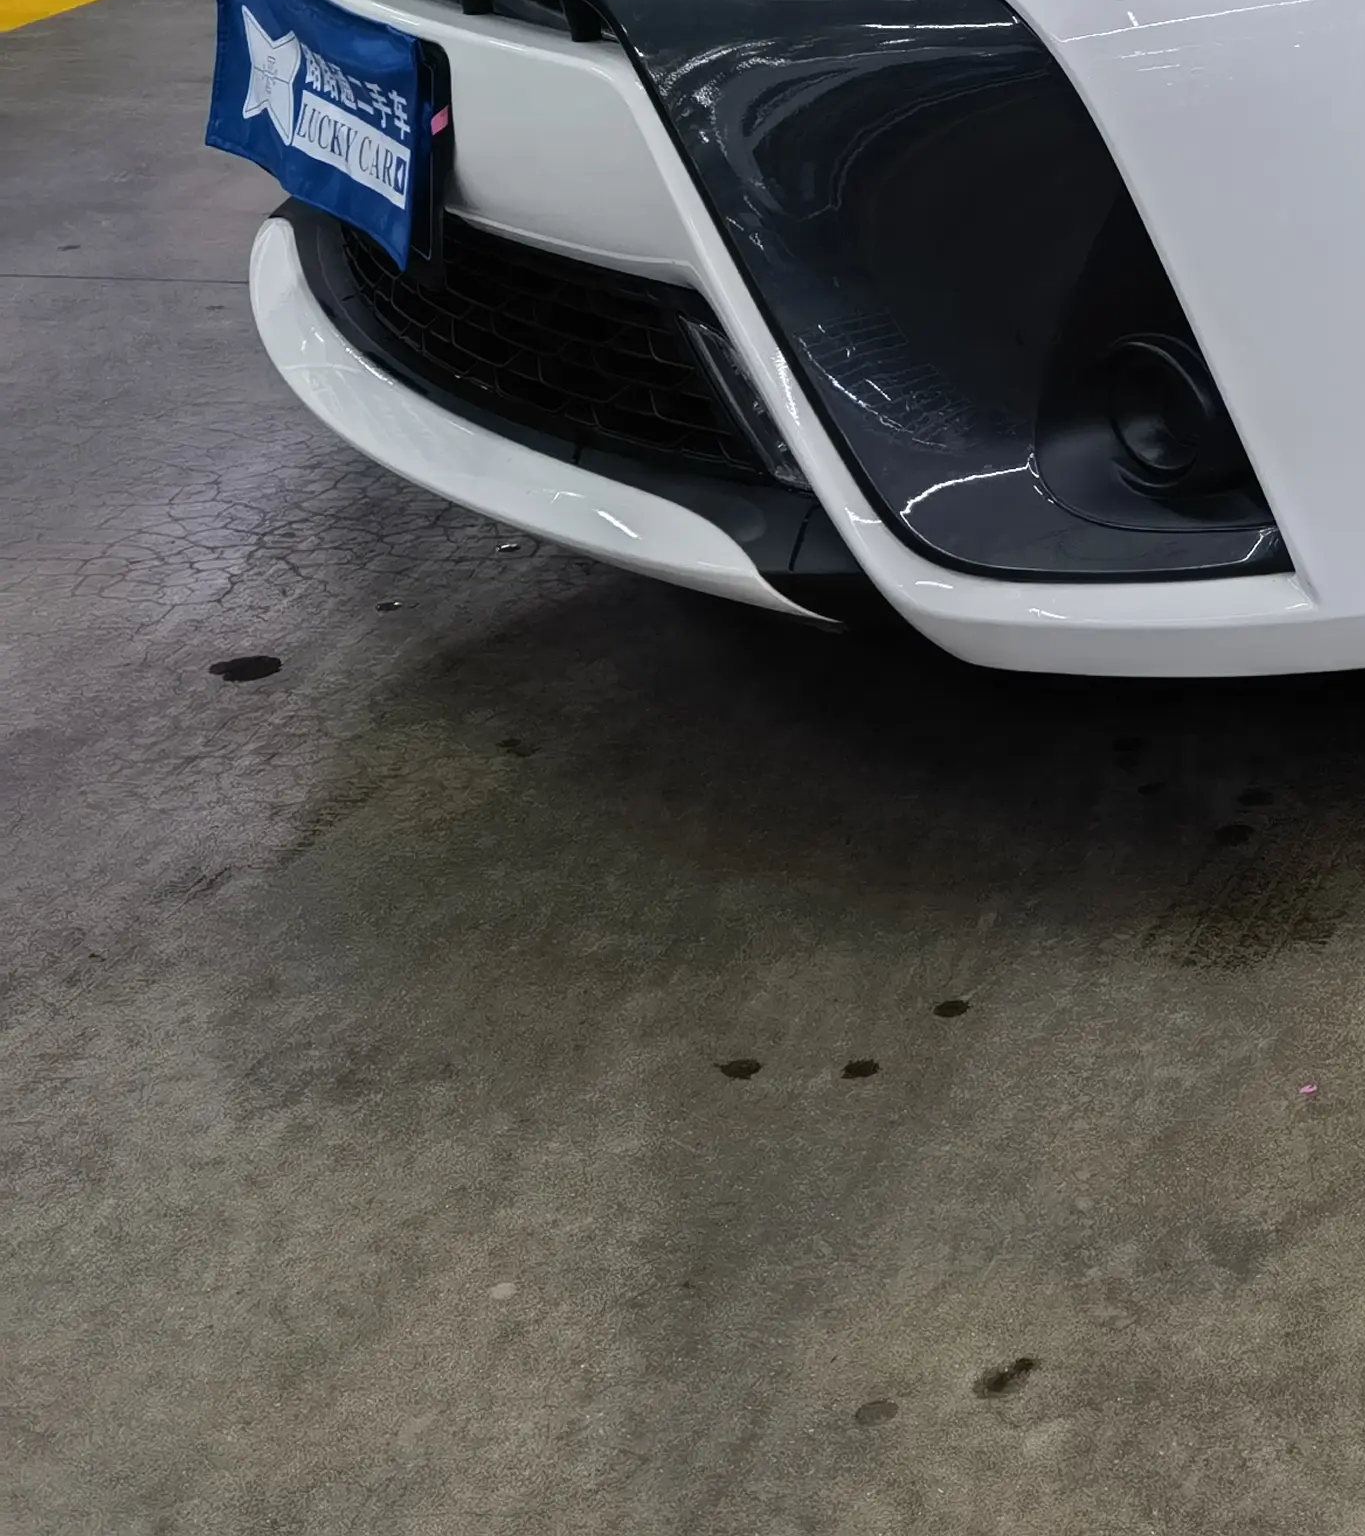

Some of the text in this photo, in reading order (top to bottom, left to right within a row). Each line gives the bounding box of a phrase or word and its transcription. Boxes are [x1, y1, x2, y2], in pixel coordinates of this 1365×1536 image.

[300, 42, 412, 140] 路路通二手车
[295, 102, 394, 189] LUCKY CAR
